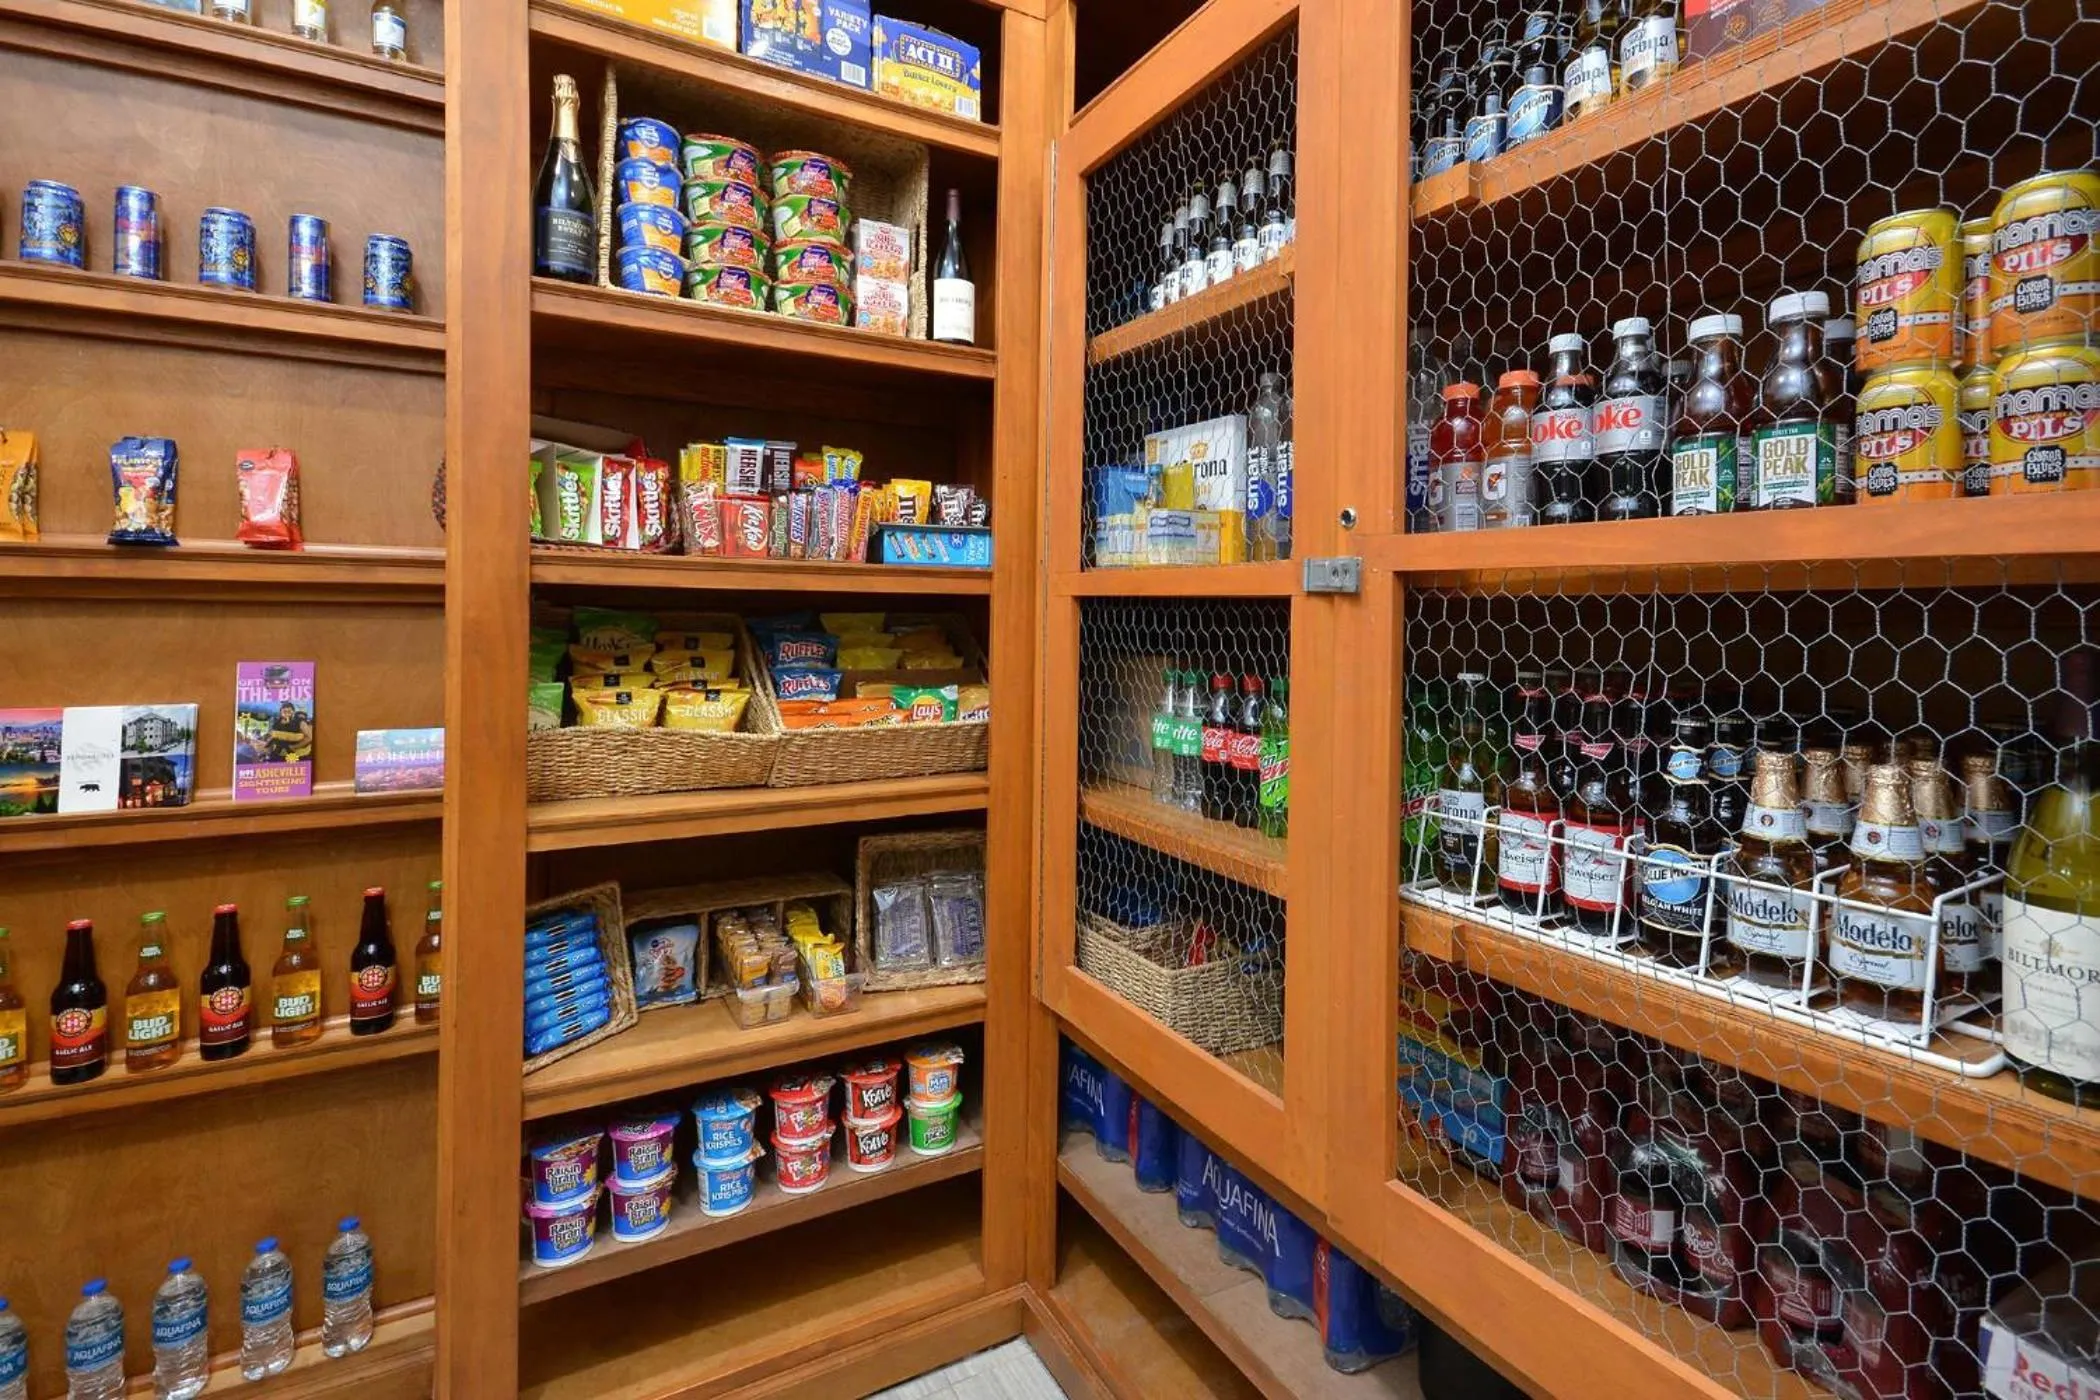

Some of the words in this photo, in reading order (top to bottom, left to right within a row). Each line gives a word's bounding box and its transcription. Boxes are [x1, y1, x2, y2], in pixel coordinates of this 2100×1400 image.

[827, 6, 868, 29] VARIETY
[836, 16, 861, 34] PACK
[907, 44, 933, 63] ACT
[935, 55, 954, 72] II
[1623, 34, 1669, 60] orona
[2004, 241, 2072, 271] PILS
[1860, 275, 1915, 303] PILS
[1533, 415, 1583, 443] oke
[2010, 416, 2084, 442] PILS
[1763, 437, 1811, 459] GOLD
[1860, 429, 1912, 457] PILS
[1190, 459, 1227, 479] rona
[1676, 451, 1711, 472] GOLD
[1763, 456, 1810, 477] PEAK
[1247, 446, 1259, 511] smart
[1276, 440, 1287, 507] smart
[560, 471, 581, 540] Skittles
[602, 471, 623, 538] Skittles
[644, 471, 662, 537] Skittles
[779, 640, 828, 661] RUFFLES
[292, 677, 312, 686] ON
[779, 676, 831, 695] RUFFLES
[238, 686, 272, 702] THE
[278, 685, 312, 701] BUS
[597, 708, 650, 722] CLASSIC
[255, 766, 306, 779] ASHEVILLE
[1673, 904, 1704, 917] WHITE
[1731, 889, 1798, 924] Modelo
[1835, 914, 1913, 951] Modelo
[1944, 915, 1971, 937] elo
[2007, 946, 2100, 983] BILTMOR
[421, 975, 441, 986] BU
[274, 1002, 314, 1018] LIGHT
[278, 995, 310, 1008] BUD
[128, 1023, 172, 1040] LIGHT
[132, 1015, 168, 1030] BUD
[862, 1085, 892, 1108] Krave
[1068, 1062, 1105, 1116] AFINA
[705, 1136, 743, 1150] KRISPIES
[712, 1131, 735, 1140] RICE
[859, 1131, 889, 1154] Krave
[546, 1163, 582, 1180] Raisin
[720, 1180, 741, 1192] RICE
[1201, 1154, 1282, 1257] AQUAFINA
[550, 1217, 586, 1235] Raisin
[156, 1317, 202, 1338] AQUAFINA
[73, 1335, 122, 1361] AQUAFINA
